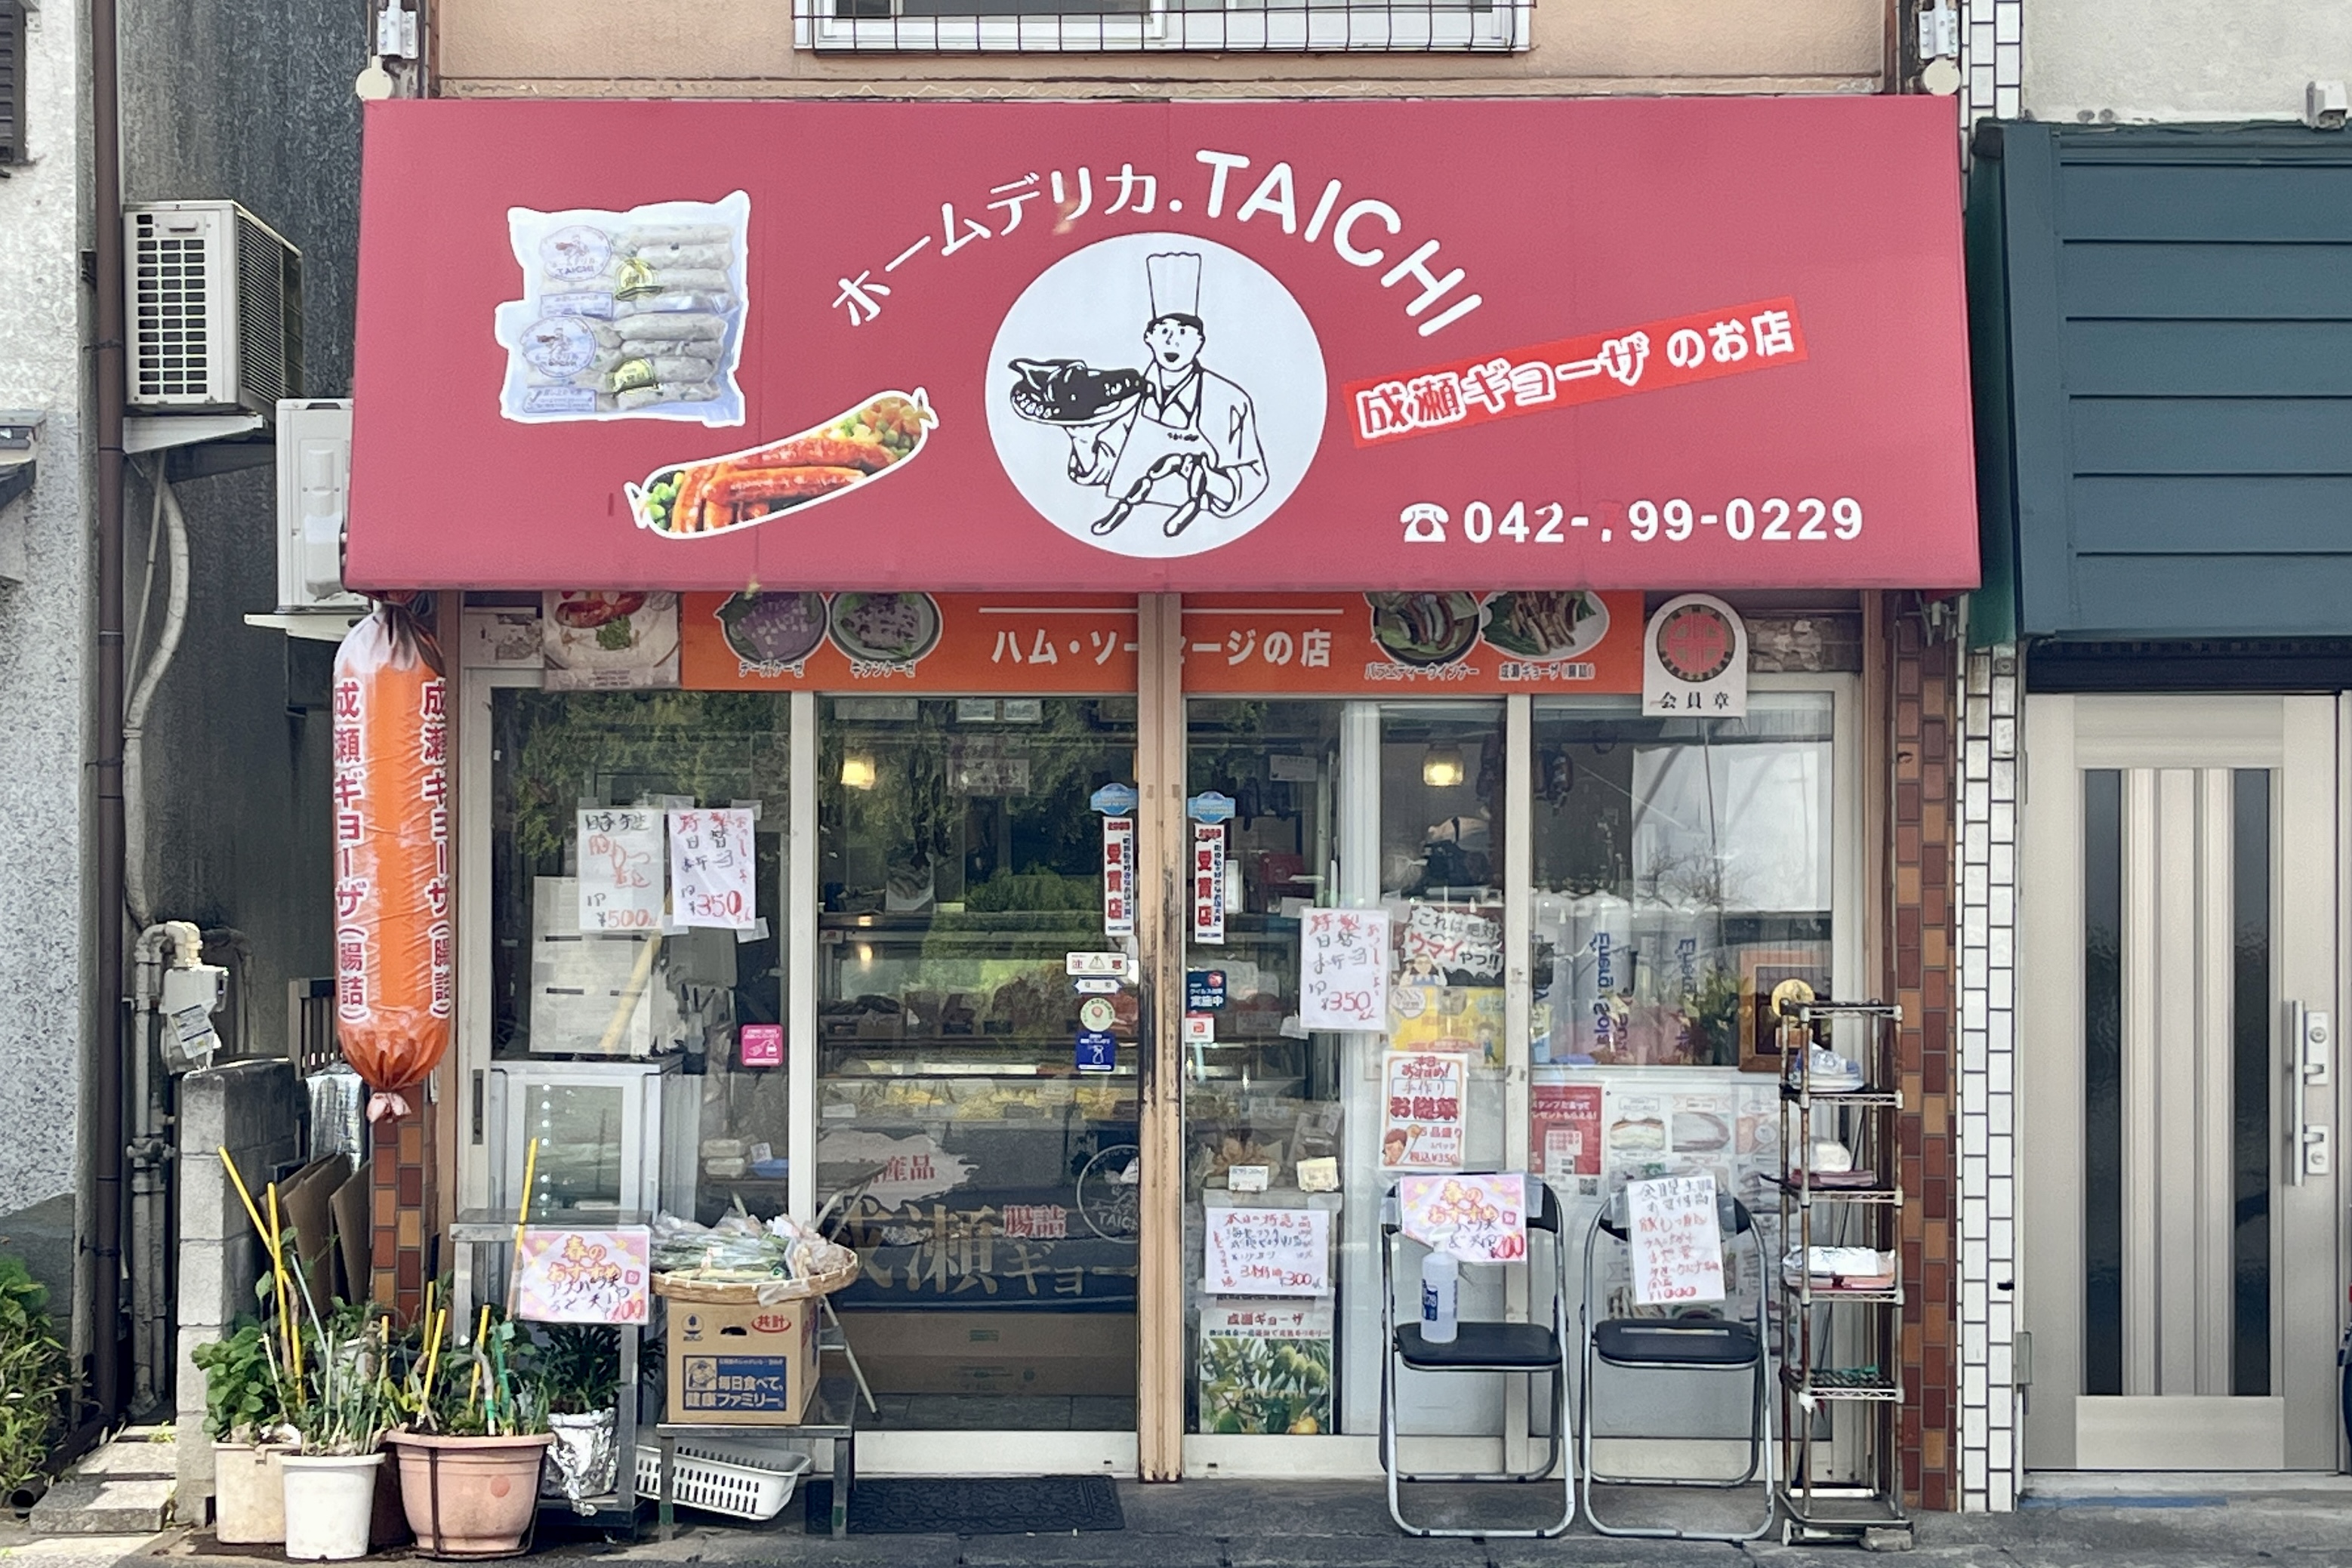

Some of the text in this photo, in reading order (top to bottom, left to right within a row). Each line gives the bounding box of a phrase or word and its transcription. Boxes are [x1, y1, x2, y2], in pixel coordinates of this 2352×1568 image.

[1195, 149, 1483, 337] TAICHI
[991, 628, 1332, 667] ハム・ソーージの店
[1409, 932, 1464, 963] ウマイ
[561, 1234, 607, 1263] 春の
